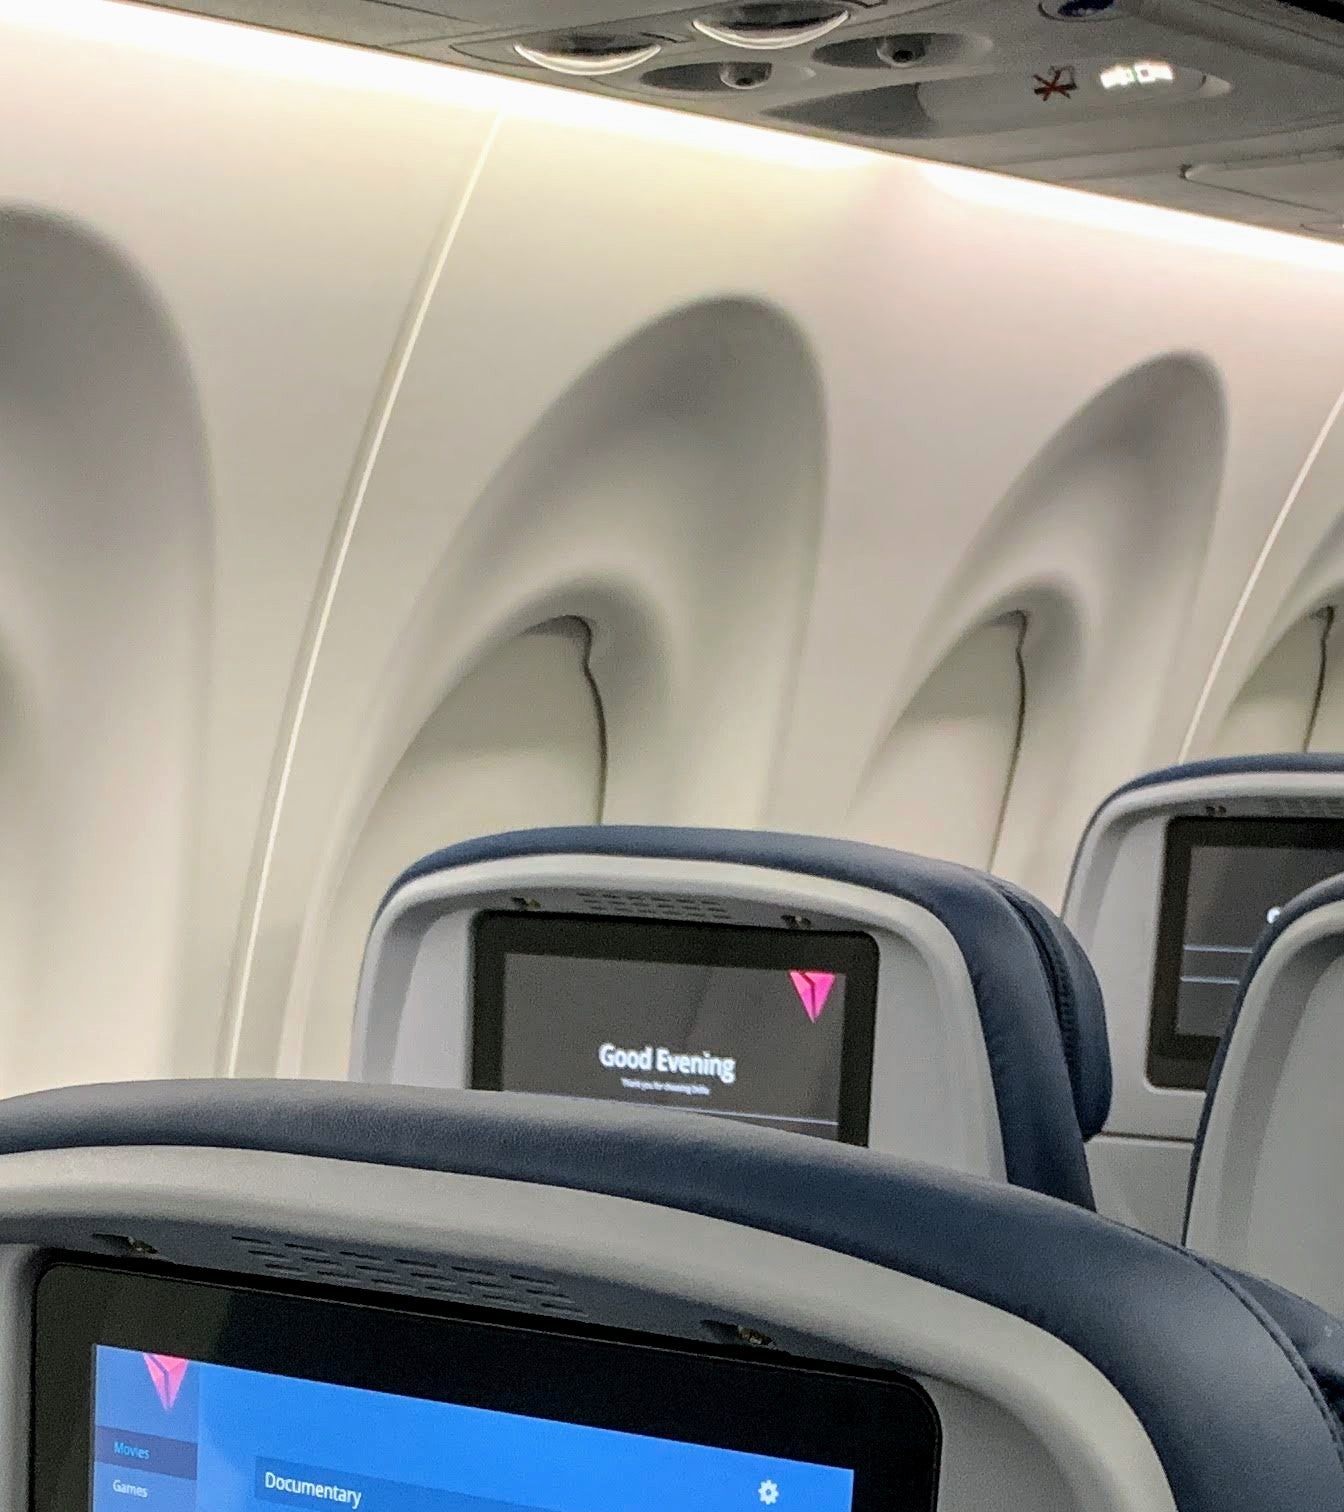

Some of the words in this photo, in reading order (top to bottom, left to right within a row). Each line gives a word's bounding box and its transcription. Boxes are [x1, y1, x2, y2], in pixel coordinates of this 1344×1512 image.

[598, 1042, 653, 1071] Good
[655, 1047, 736, 1084] Evening
[113, 1441, 150, 1460] Movies
[113, 1480, 148, 1498] Games
[265, 1472, 362, 1510] Documentary
